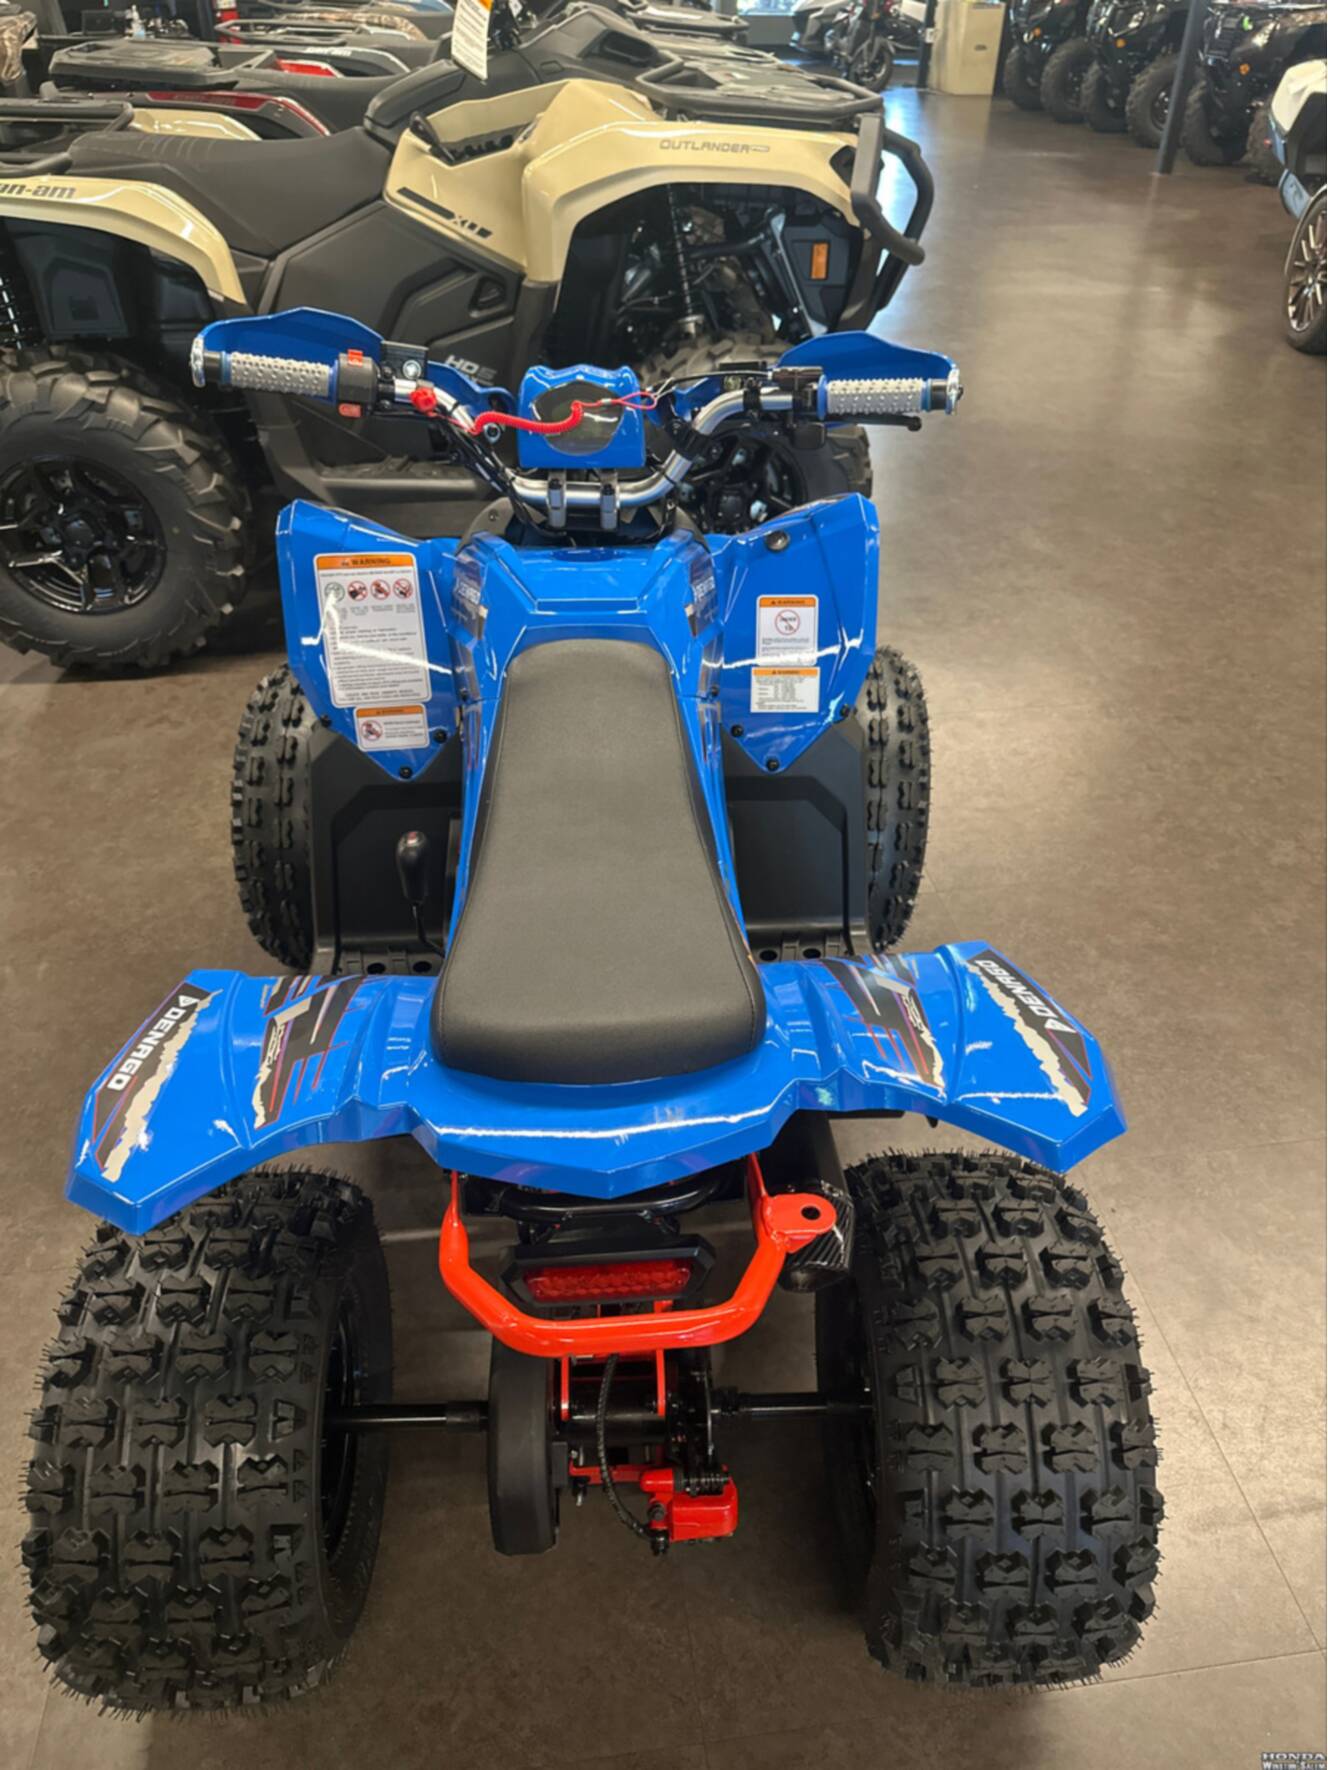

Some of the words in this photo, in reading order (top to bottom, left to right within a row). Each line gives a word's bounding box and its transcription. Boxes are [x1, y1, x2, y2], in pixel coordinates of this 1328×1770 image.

[659, 139, 751, 154] OUTLANDER
[974, 959, 1058, 1019] DENAGO
[107, 1007, 187, 1091] DENAGO
